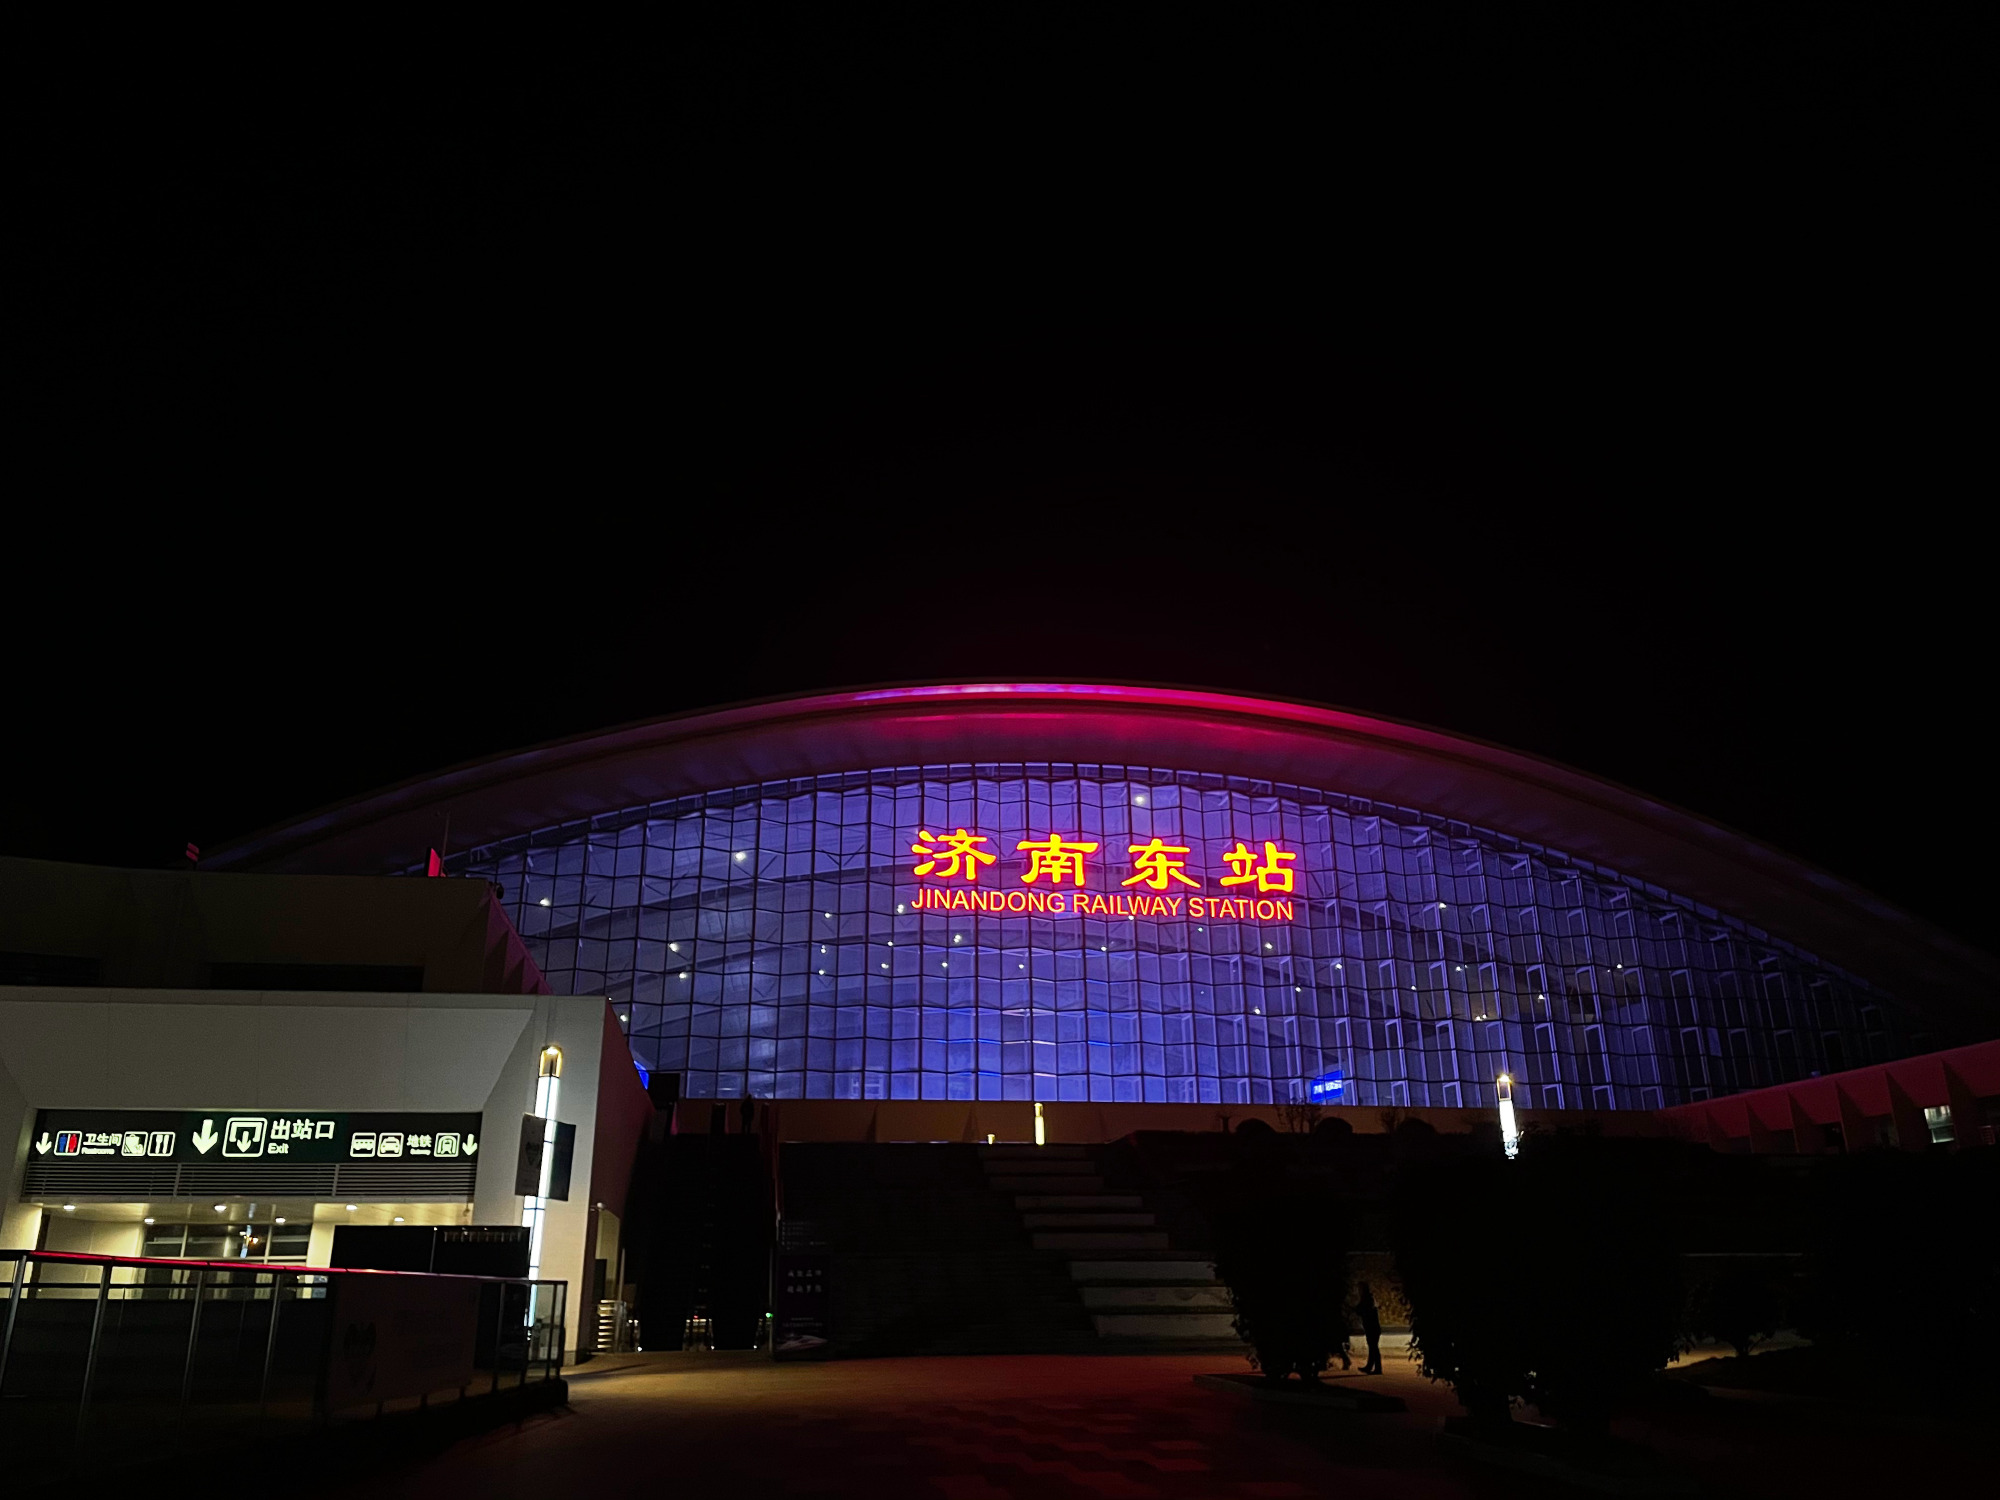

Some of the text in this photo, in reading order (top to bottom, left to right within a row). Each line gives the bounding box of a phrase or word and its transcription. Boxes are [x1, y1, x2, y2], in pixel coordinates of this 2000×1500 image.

[912, 829, 1296, 892] 济南东站
[911, 889, 1293, 920] JINANDONG RAILWAY STATION
[82, 1132, 123, 1146] 卫生间
[270, 1119, 335, 1140] 出站口
[267, 1142, 289, 1154] Exit
